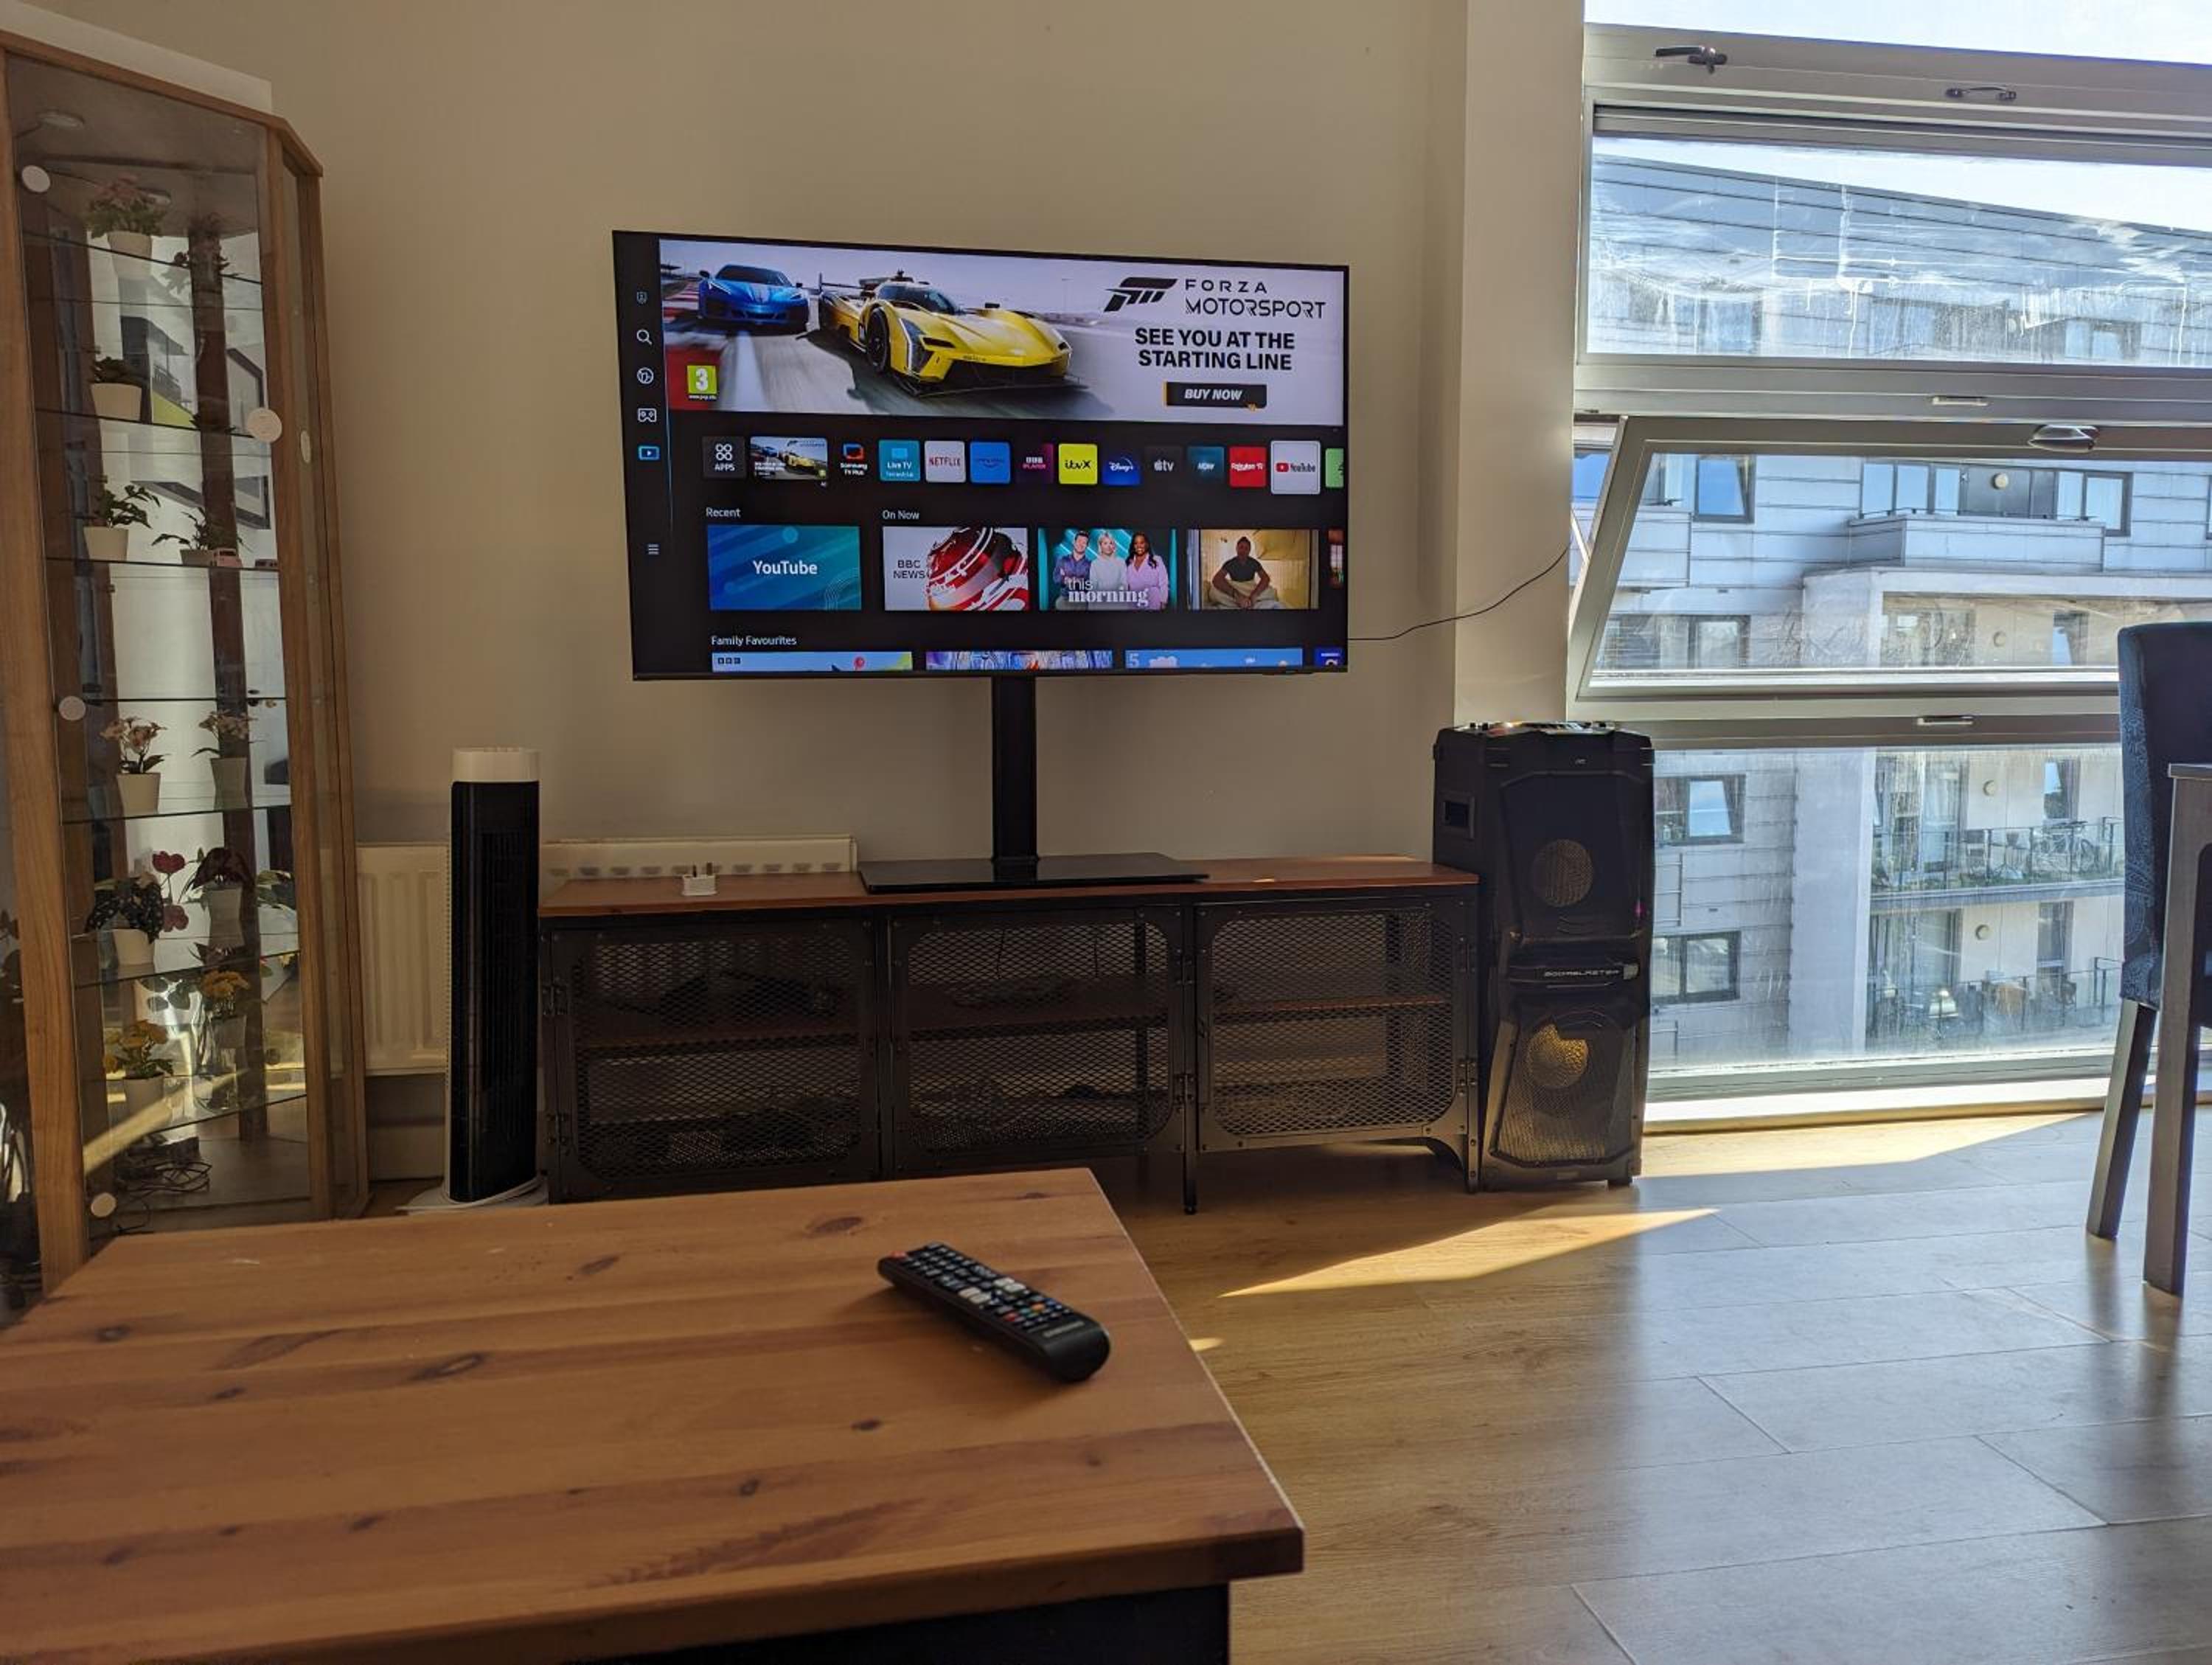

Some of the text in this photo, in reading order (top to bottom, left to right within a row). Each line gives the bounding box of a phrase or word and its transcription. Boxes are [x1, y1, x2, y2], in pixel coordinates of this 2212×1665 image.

[1185, 279, 1267, 293] FORZA
[1185, 297, 1326, 319] MOTORSPORT
[1135, 327, 1295, 350] SEE YOU AT THE
[1138, 350, 1293, 370] STARTING LINE
[695, 368, 709, 392] 3
[1184, 389, 1243, 400] BUY NOW
[929, 456, 961, 466] NETFLIX
[714, 463, 735, 471] APPS
[1290, 462, 1315, 473] YouTube
[706, 507, 741, 518] Recent
[883, 510, 919, 520] On Now
[753, 560, 818, 574] YouTube
[897, 560, 921, 569] BBC
[893, 570, 925, 579] NEWS
[1068, 577, 1093, 590] this
[1068, 587, 1148, 607] morning
[711, 636, 797, 646] Family Favourites
